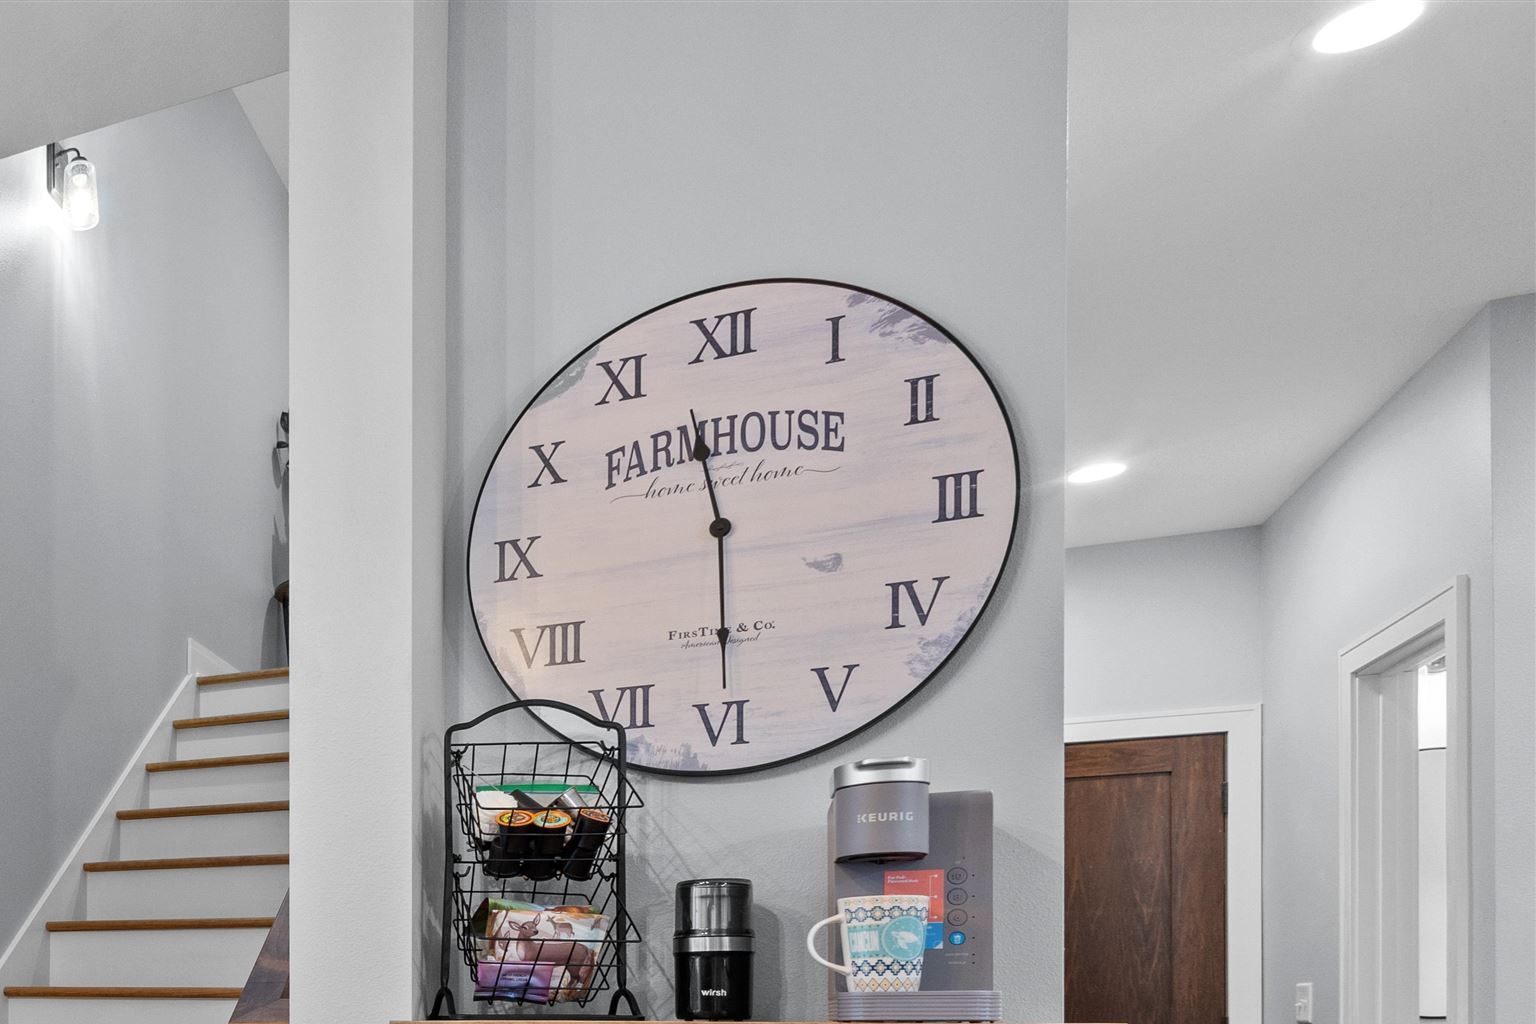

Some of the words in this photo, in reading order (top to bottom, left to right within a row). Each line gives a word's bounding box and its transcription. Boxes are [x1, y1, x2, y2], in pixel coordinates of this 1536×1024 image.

[688, 306, 757, 366] XII
[825, 314, 846, 365] I
[595, 353, 647, 406] XI
[904, 373, 941, 427] II
[528, 440, 568, 489] X
[605, 409, 846, 491] FARMHOUSE
[644, 475, 696, 500] home
[749, 459, 805, 485] home
[932, 469, 985, 524] III
[494, 536, 543, 584] IX
[736, 622, 749, 633] &
[885, 576, 950, 631] IV
[510, 620, 586, 669] VIII
[589, 684, 655, 732] VII
[811, 664, 859, 713] V
[692, 700, 750, 748] VI
[856, 811, 914, 824] KEURIG
[700, 988, 728, 998] wirsh
